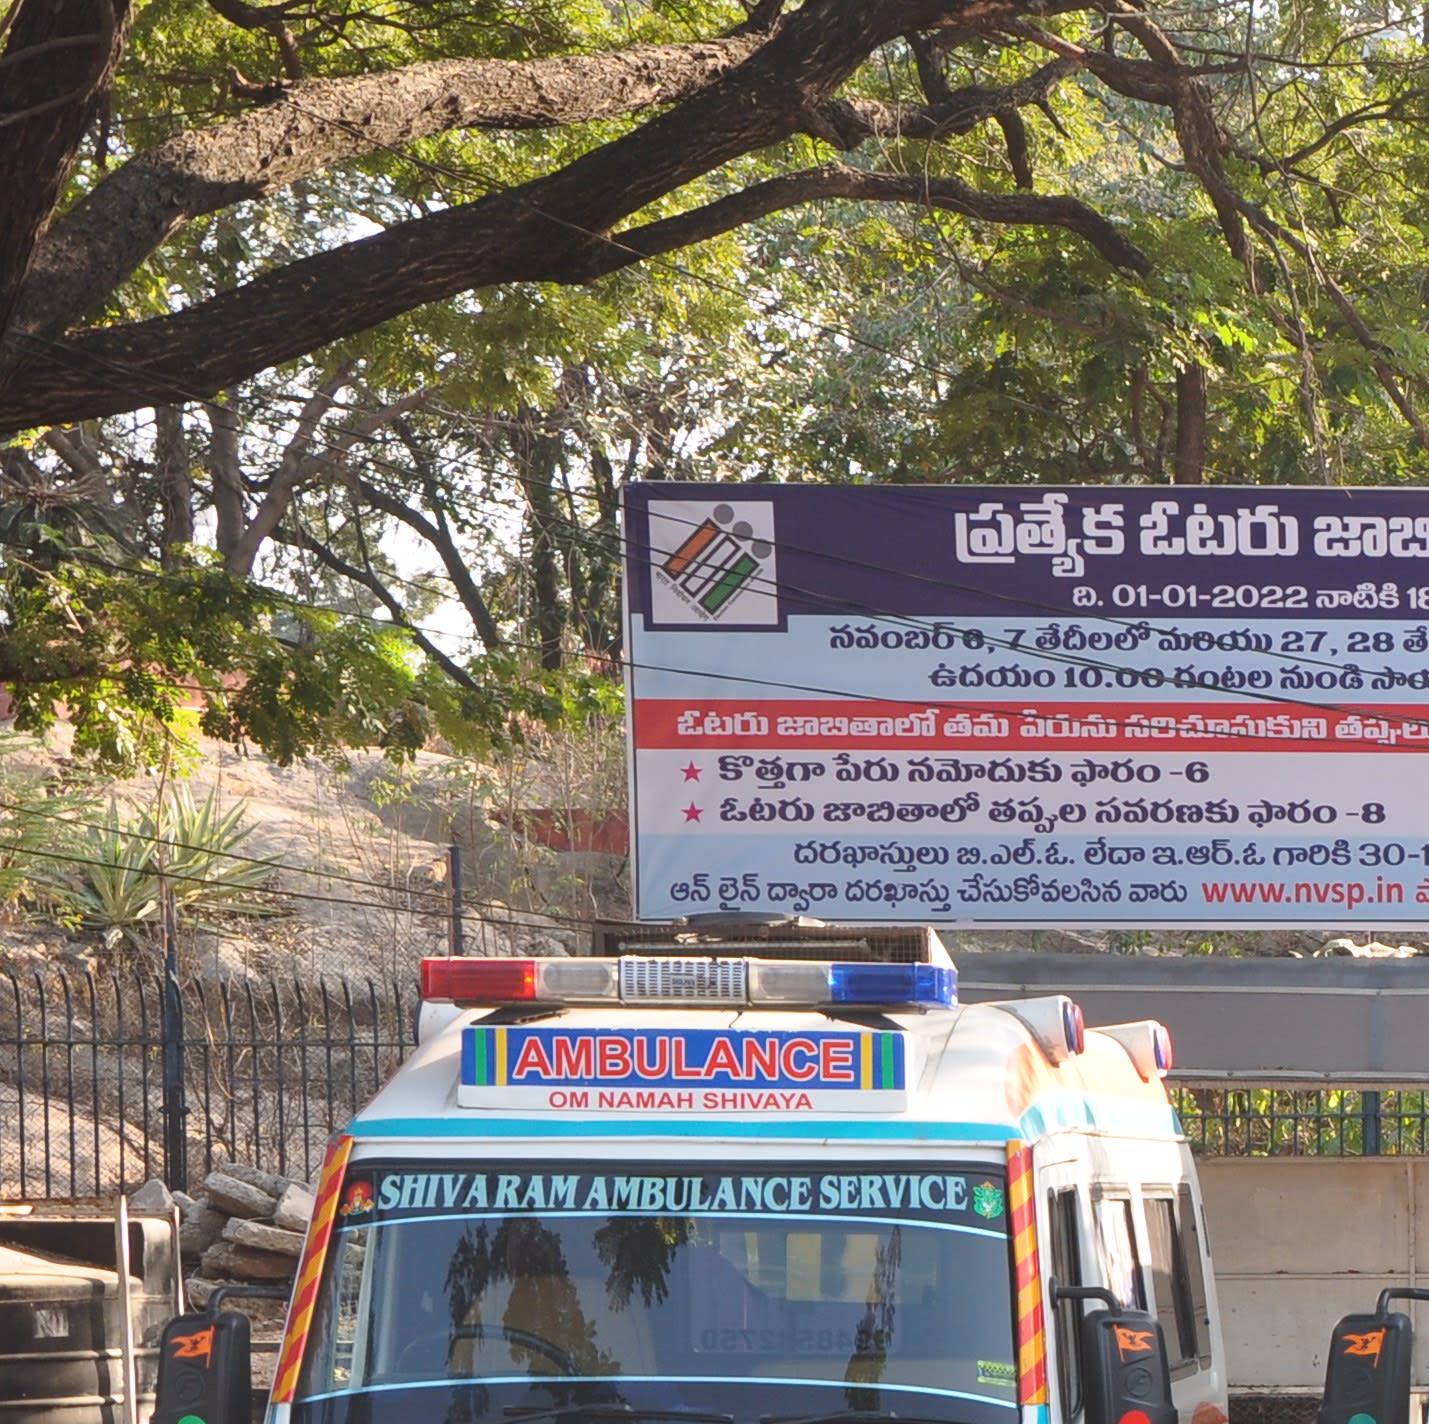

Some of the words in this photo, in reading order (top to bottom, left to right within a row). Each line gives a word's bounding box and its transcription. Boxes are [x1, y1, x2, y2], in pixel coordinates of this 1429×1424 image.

[955, 493, 1125, 577] ప్రత్యేక
[1139, 501, 1299, 557] ఓటరు
[1112, 584, 1309, 609] 01-01-2022
[1316, 582, 1400, 610] నాటికి
[829, 623, 955, 651] నవంబర్
[1035, 621, 1151, 652] తేదీలలో
[1158, 627, 1272, 652] మరియు
[1347, 631, 1395, 653] 28
[928, 662, 1056, 688] ఉదయం
[1173, 665, 1272, 690] గంటల
[1280, 665, 1364, 691] నుండి
[677, 710, 768, 737] ఓటరు
[777, 709, 936, 738] జాబితాలో
[944, 713, 1009, 739] తమ
[717, 753, 825, 789] కొత్తగా
[834, 752, 899, 783] పేరు
[907, 756, 1062, 783] నమోదుకు
[1070, 756, 1161, 788] ఫారం
[1169, 761, 1210, 784] -6
[719, 797, 815, 824] ఓటరు
[823, 791, 980, 824] జాబితాలో
[988, 797, 1087, 834] తప్పుల
[1095, 798, 1240, 825] సవరణకు
[1247, 799, 1337, 828] ఫారం
[1345, 801, 1387, 824] -8
[793, 841, 950, 873] దరఖాస్తులు
[1084, 836, 1146, 865] లేదా
[1273, 838, 1352, 866] గారికి
[670, 873, 711, 903] ఆన్
[718, 873, 760, 912] లైన్
[767, 879, 837, 912] ద్వారా
[845, 877, 951, 912] దరఖాస్తు
[956, 875, 1121, 904] చేసుకోవలసిన
[1129, 879, 1187, 904] వారు
[1201, 876, 1404, 909] www.nvsp.in
[513, 1035, 855, 1082] AMBULANCE
[547, 1091, 590, 1110] OM
[597, 1091, 694, 1111] NAMAH
[702, 1092, 814, 1111] SHIVAYA
[377, 1173, 488, 1210] SHIVA
[497, 1174, 577, 1210] RAM
[587, 1175, 812, 1212] AMBULANCE
[818, 1174, 969, 1211] SERVICE
